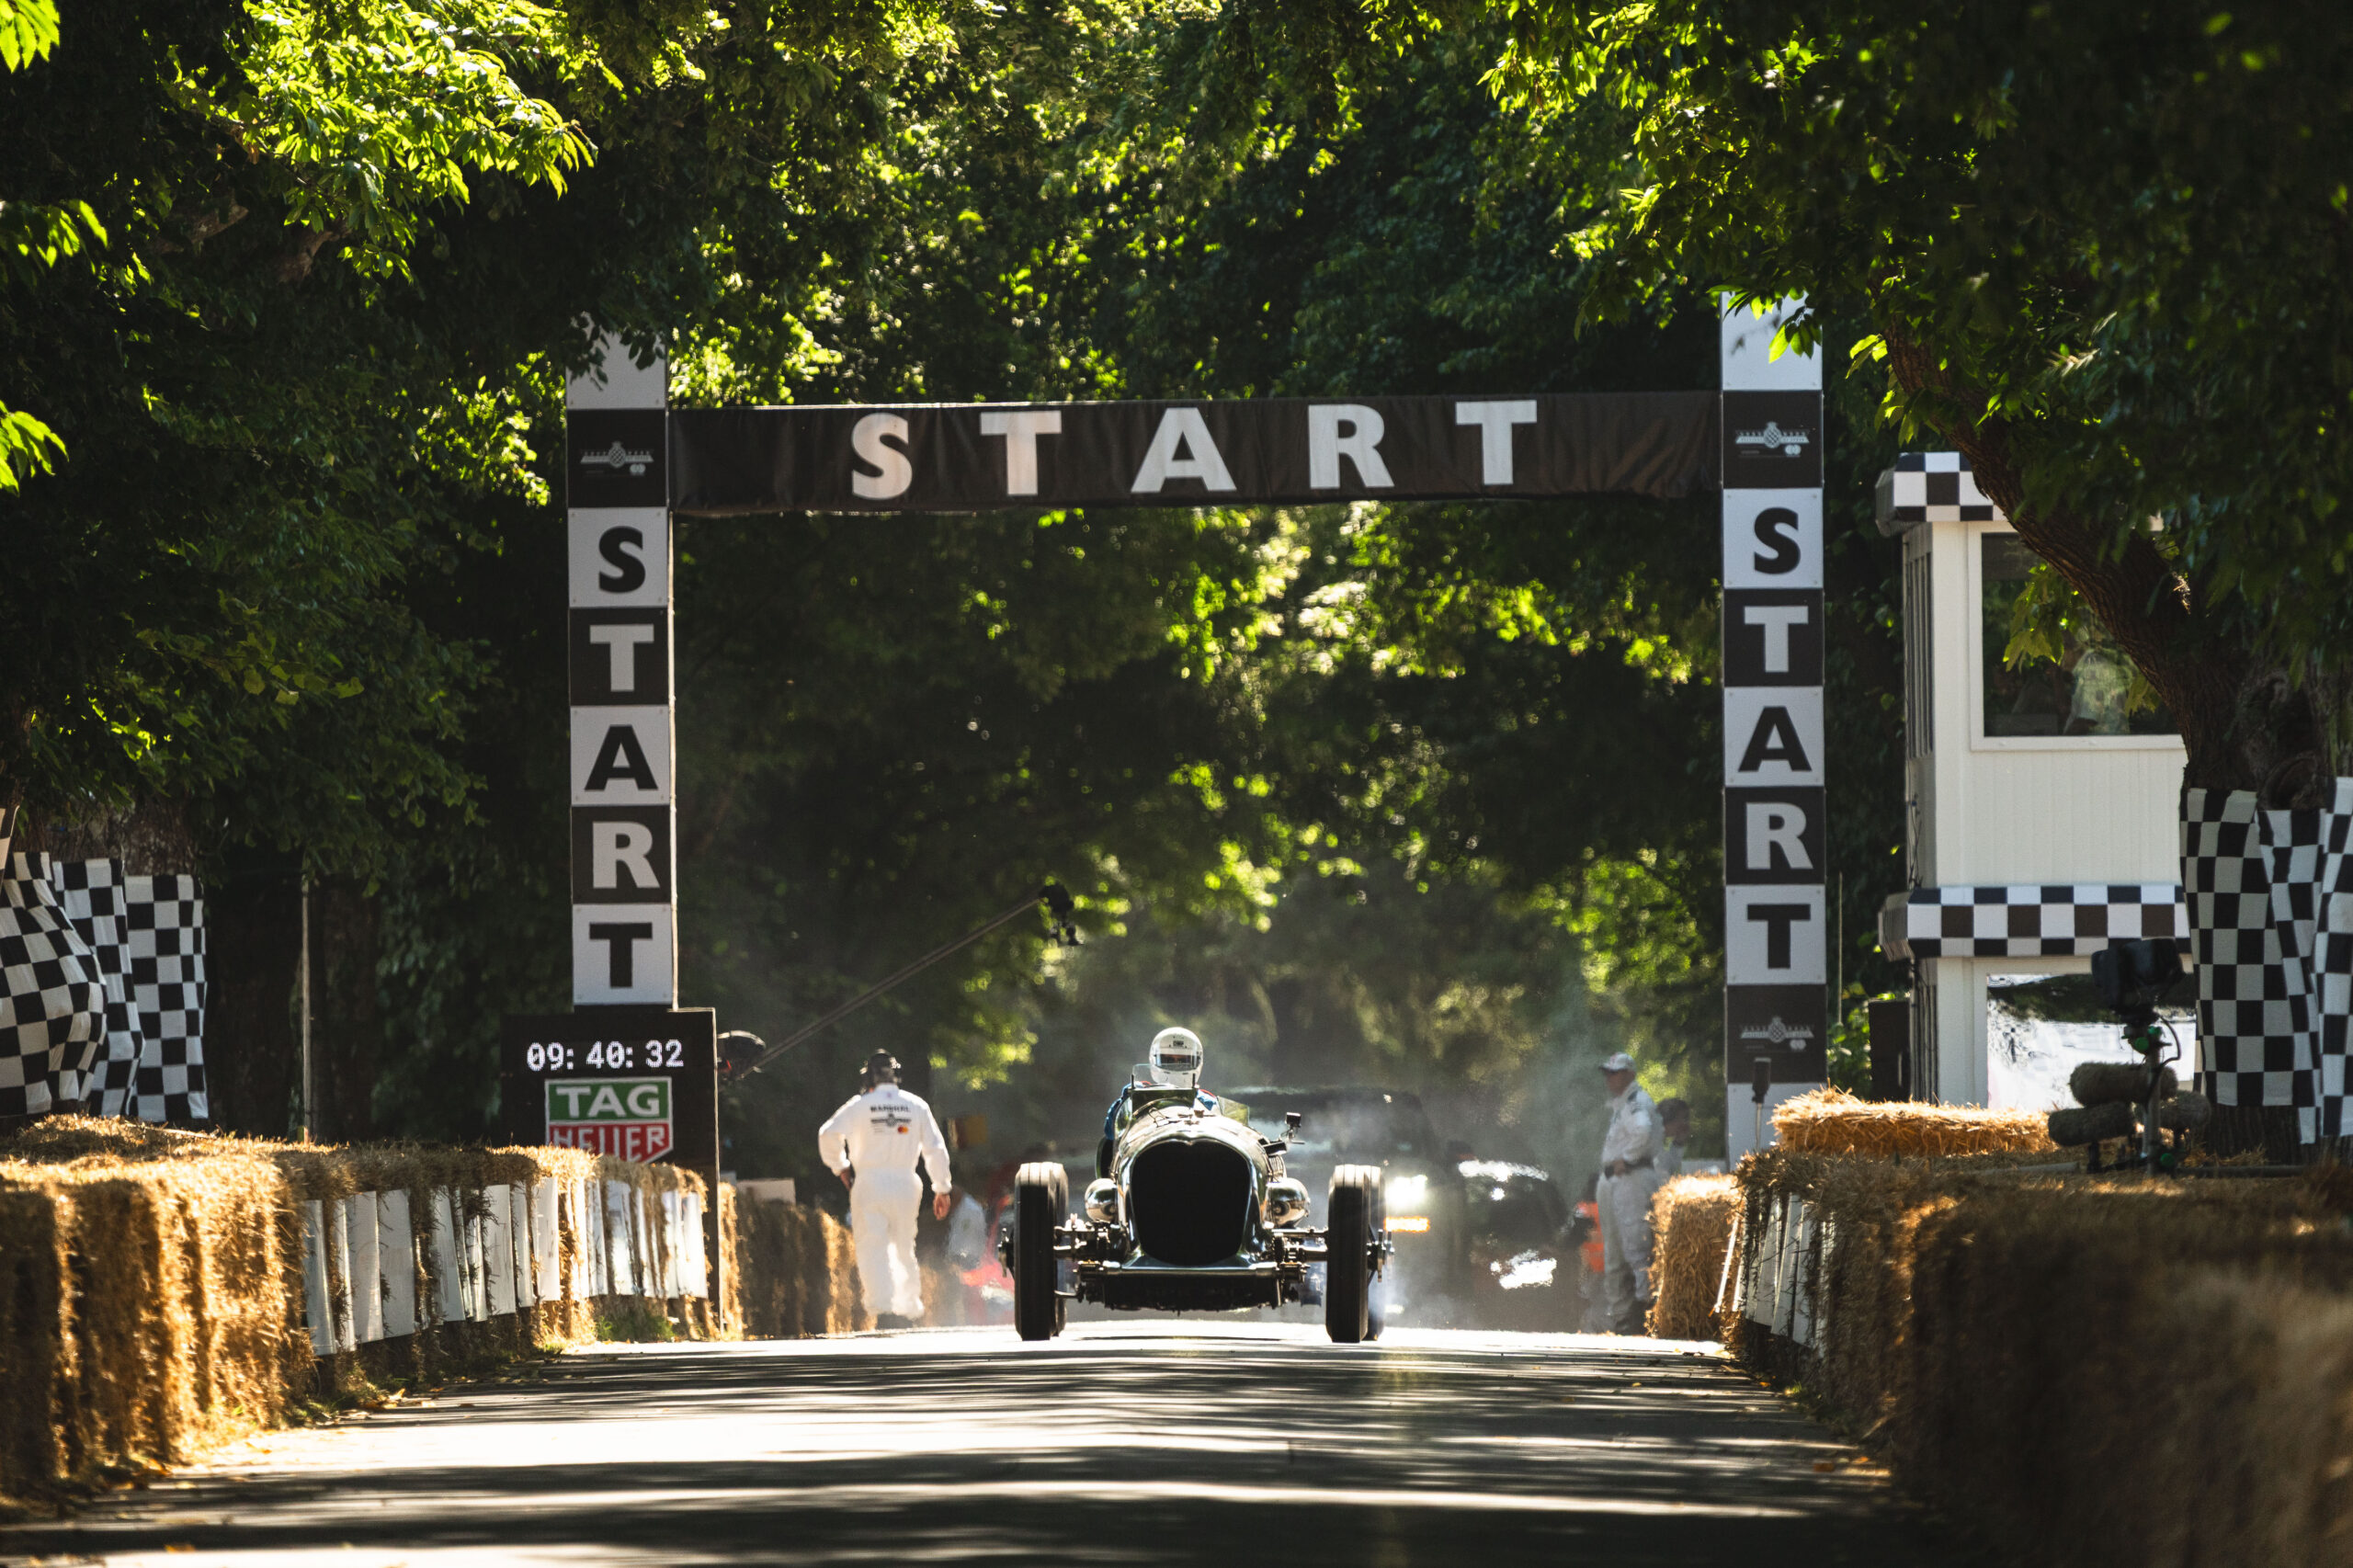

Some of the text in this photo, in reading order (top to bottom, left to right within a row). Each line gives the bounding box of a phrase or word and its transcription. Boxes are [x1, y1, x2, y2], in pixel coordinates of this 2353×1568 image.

[852, 400, 1538, 500] START
[584, 526, 660, 988] START
[1738, 507, 1813, 969] START
[556, 1085, 660, 1118] TAG
